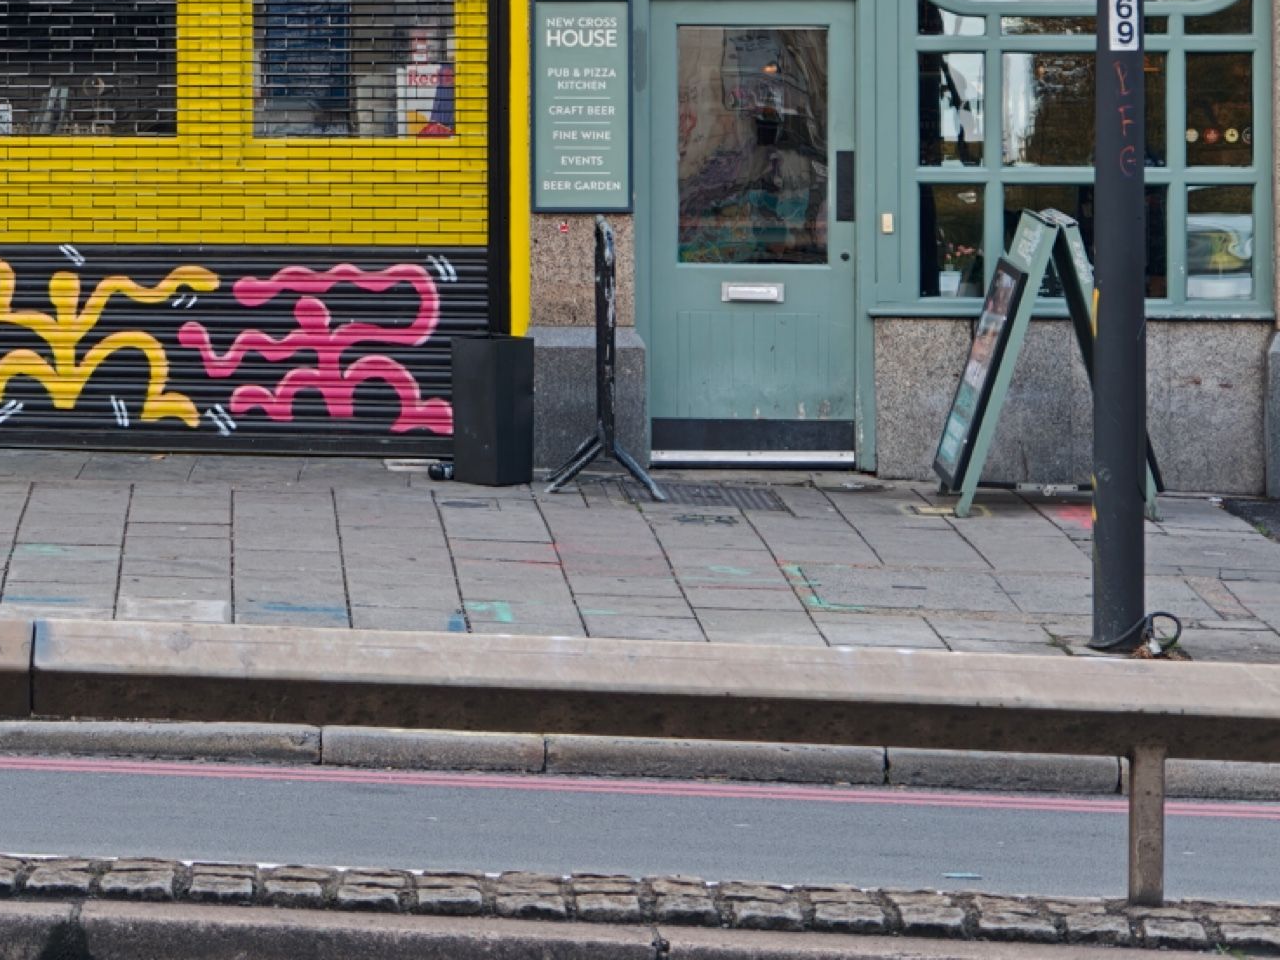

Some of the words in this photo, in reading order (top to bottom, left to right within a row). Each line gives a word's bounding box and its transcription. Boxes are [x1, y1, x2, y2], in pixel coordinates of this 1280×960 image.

[546, 17, 575, 28] NEW
[577, 17, 617, 28] CROSS
[546, 29, 618, 48] HOUSE
[547, 68, 569, 78] PUB
[573, 68, 580, 78] &
[584, 68, 617, 78] PIZZA
[557, 81, 607, 91] KITCHEN
[548, 106, 584, 116] CRAFT
[587, 106, 615, 115] BEER
[552, 130, 578, 140] FINE
[581, 130, 611, 140] WINE
[561, 156, 604, 166] EVENTS
[543, 180, 571, 190] BEER
[574, 180, 621, 191] GARDEN
